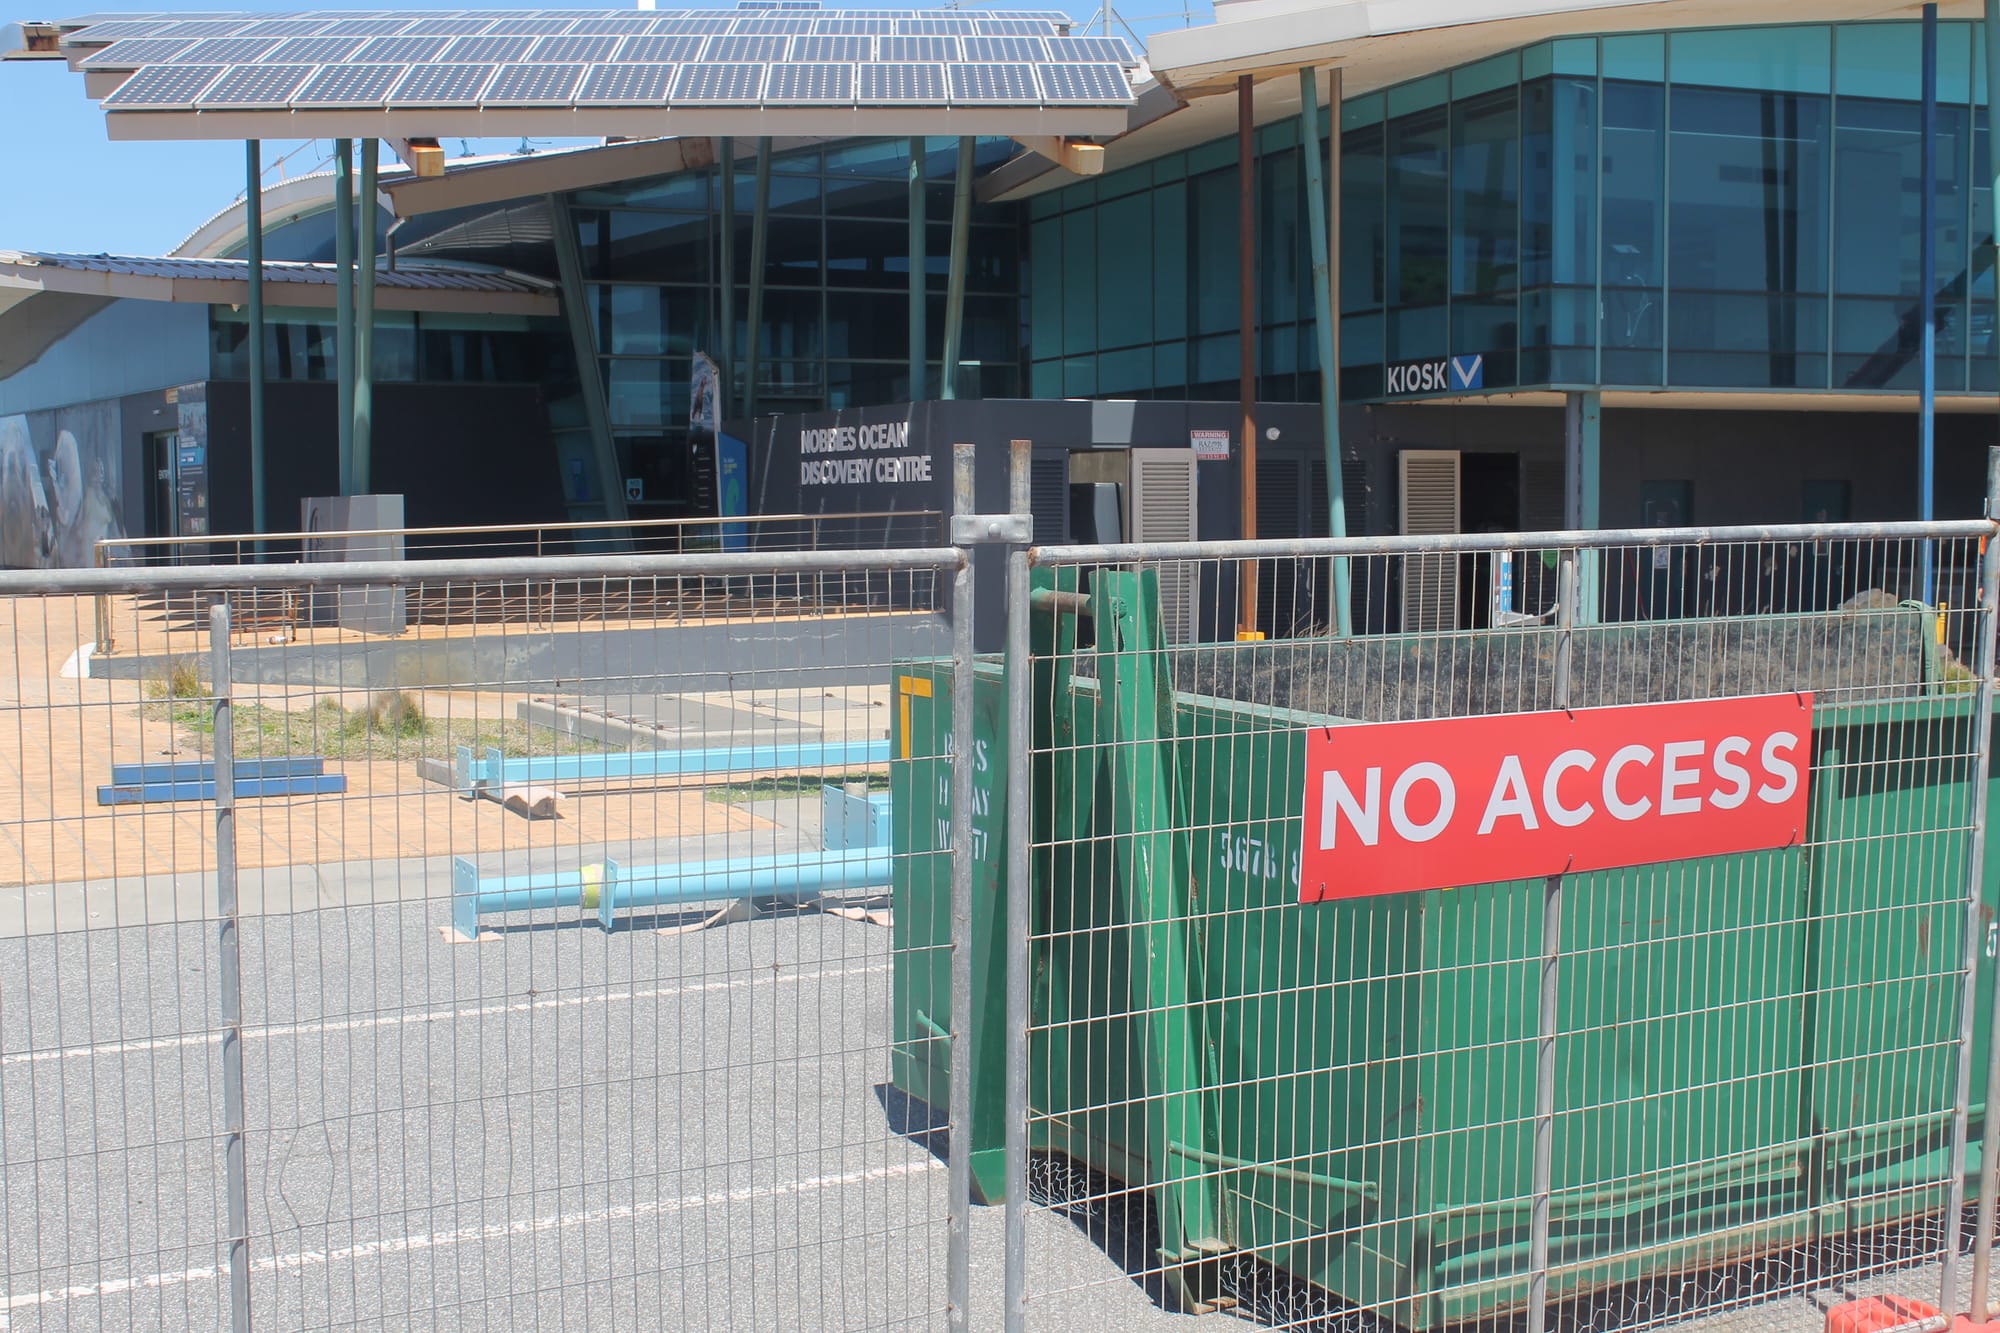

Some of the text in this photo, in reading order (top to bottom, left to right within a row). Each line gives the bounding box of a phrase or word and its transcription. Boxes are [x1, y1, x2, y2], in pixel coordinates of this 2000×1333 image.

[1387, 361, 1447, 393] KIOSK
[800, 421, 909, 454] NOBBIES OCEAN
[800, 455, 932, 485] DISCOVERY CENTRE
[1319, 731, 1799, 851] NO ACCESS
